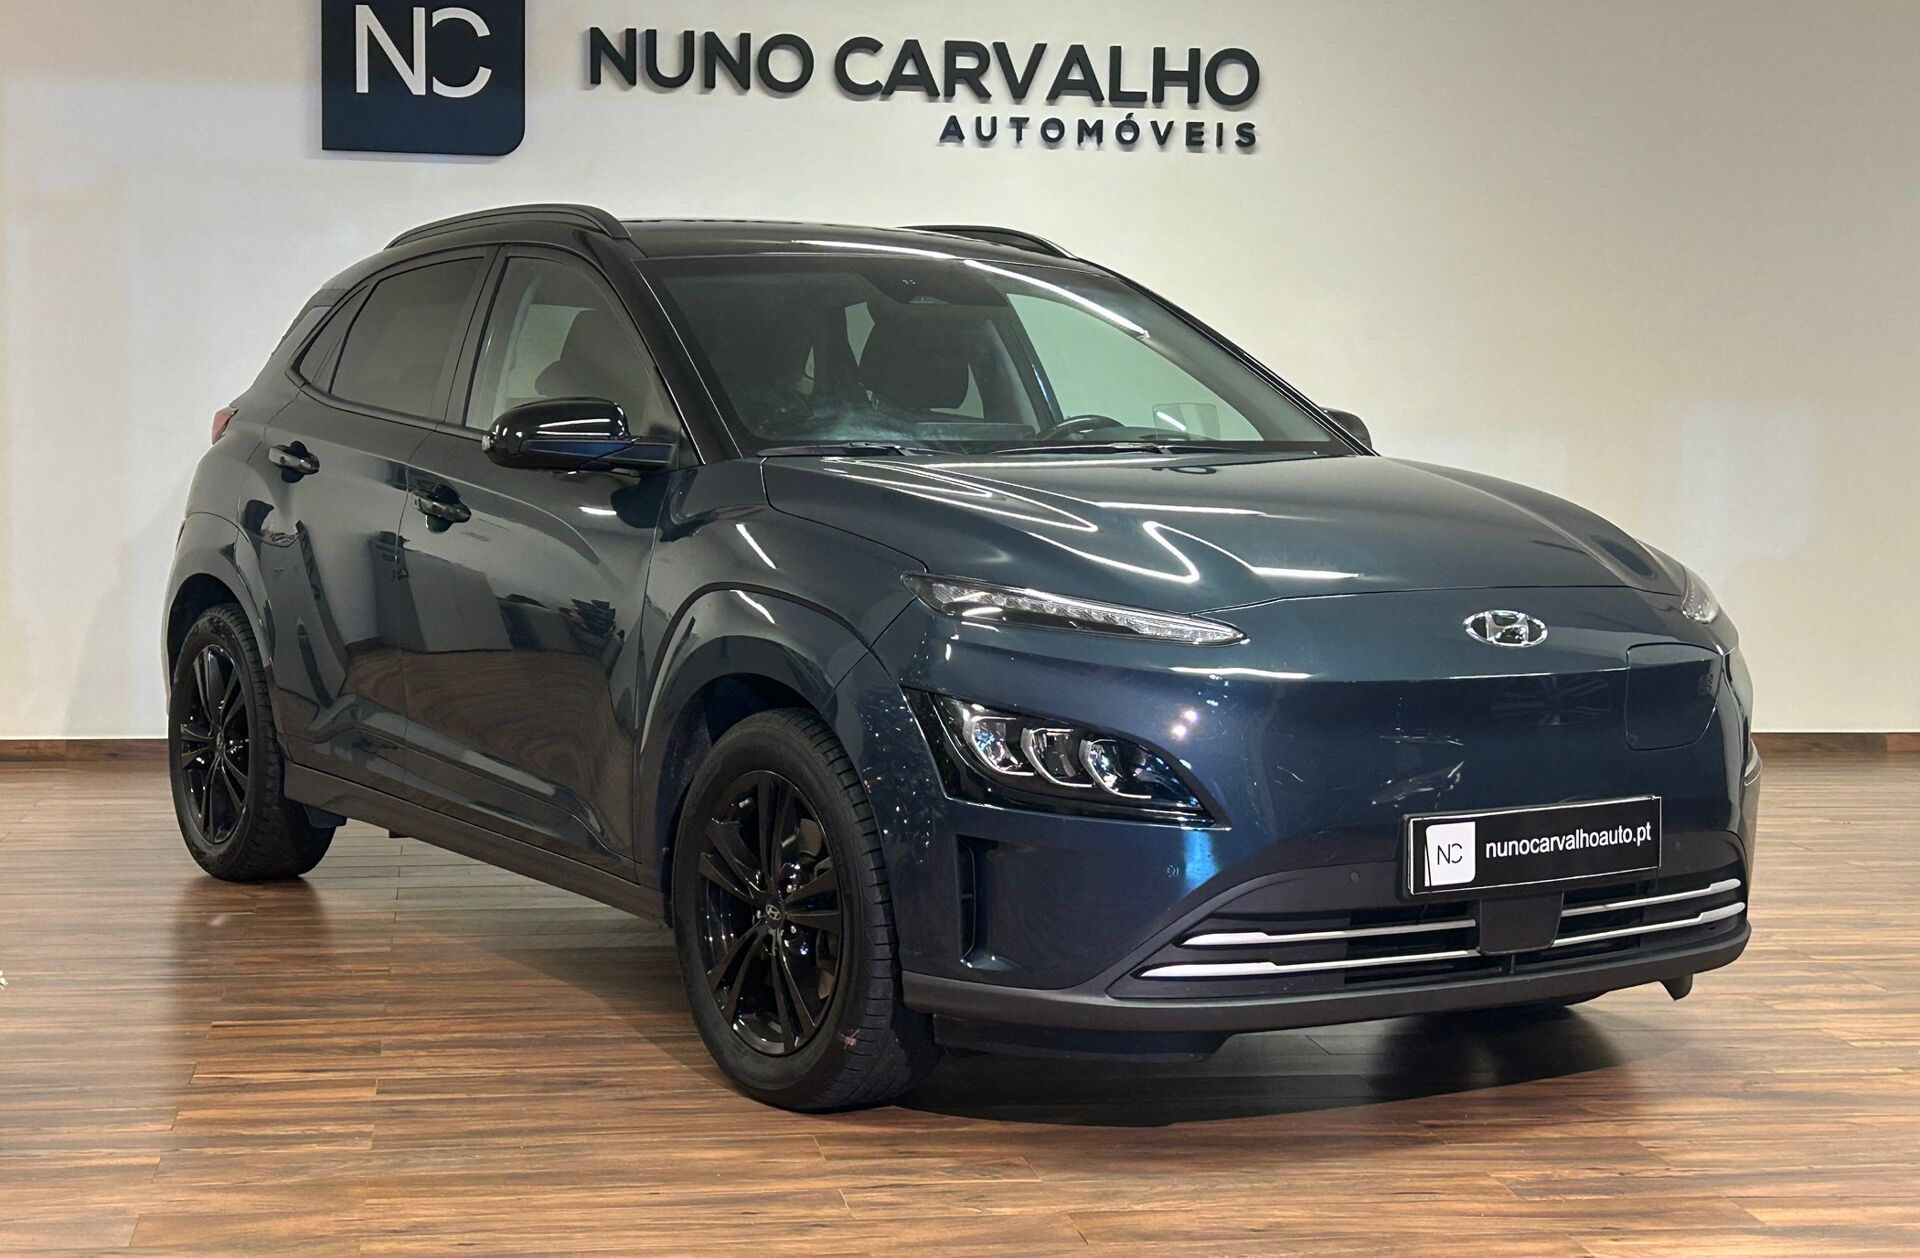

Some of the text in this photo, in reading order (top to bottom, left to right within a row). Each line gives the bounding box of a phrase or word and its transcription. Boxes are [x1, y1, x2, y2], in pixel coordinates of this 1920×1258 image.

[590, 27, 1260, 105] NUNO CARVALHO
[940, 113, 1257, 148] AUTOMÓVEIS
[1485, 821, 1652, 859] nunocarvalhoauto.pt
